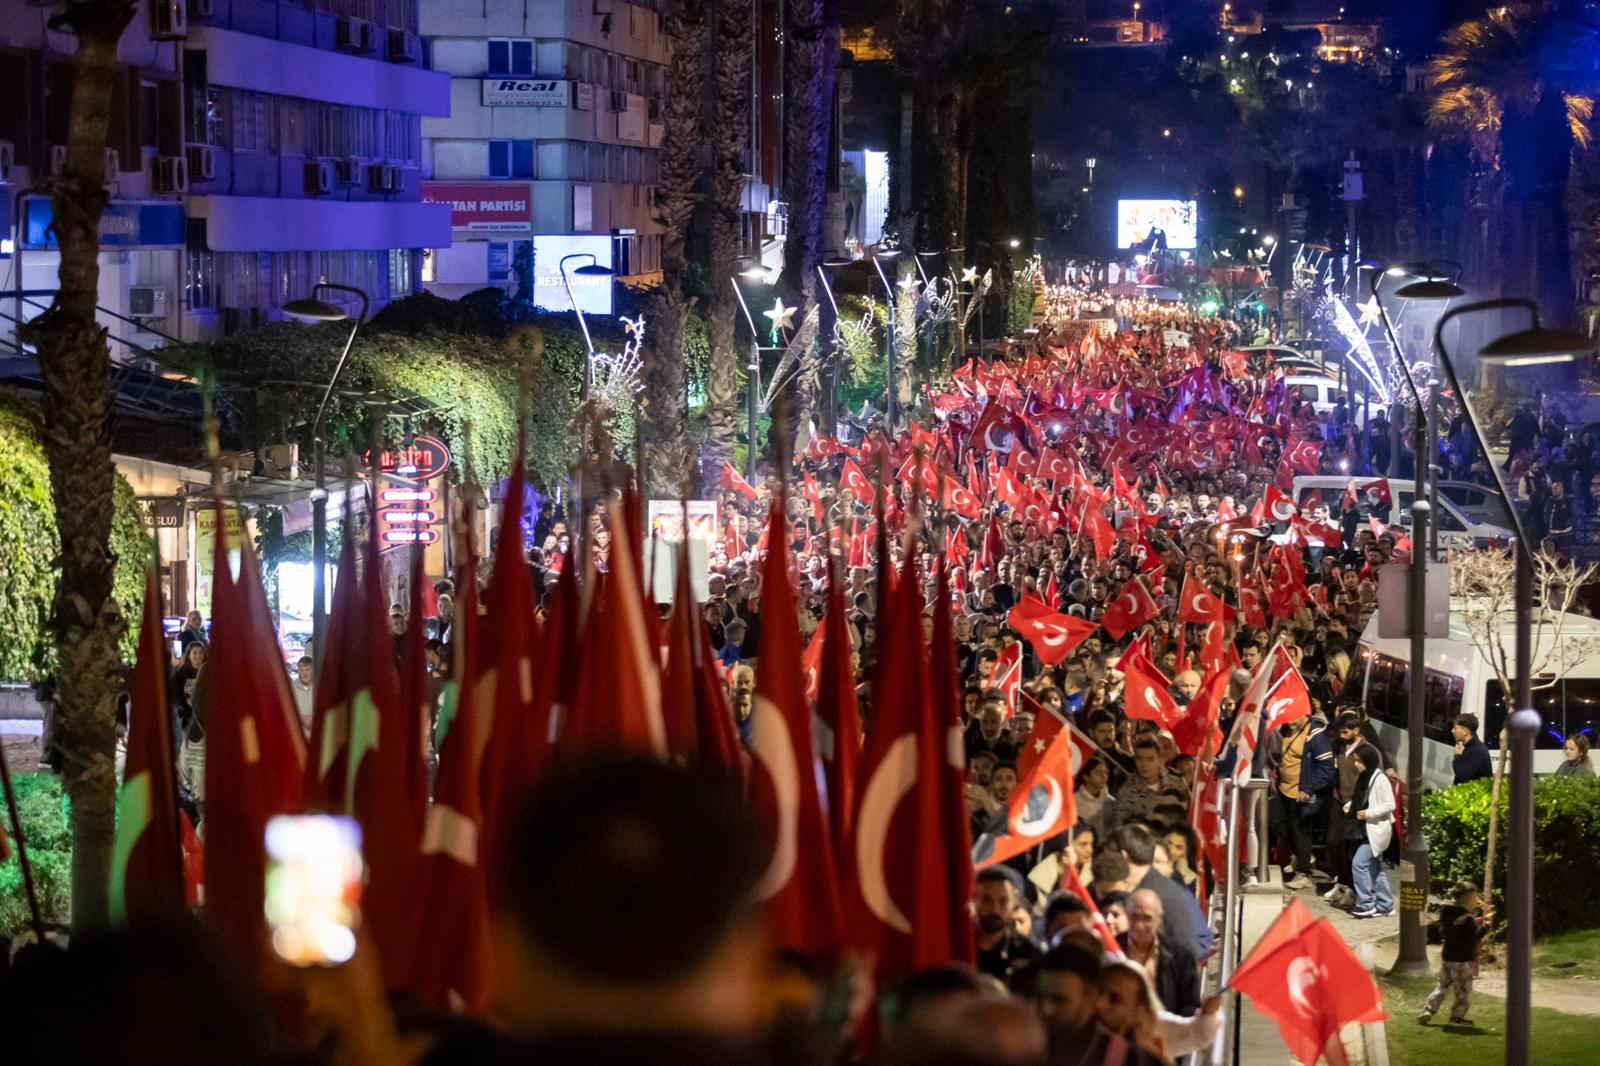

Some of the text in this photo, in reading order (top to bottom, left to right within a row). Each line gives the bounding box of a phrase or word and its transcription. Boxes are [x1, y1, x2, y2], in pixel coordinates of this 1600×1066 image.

[499, 81, 558, 91] Real
[537, 276, 606, 287] RESTURANT
[200, 519, 242, 529] KAMANYA
